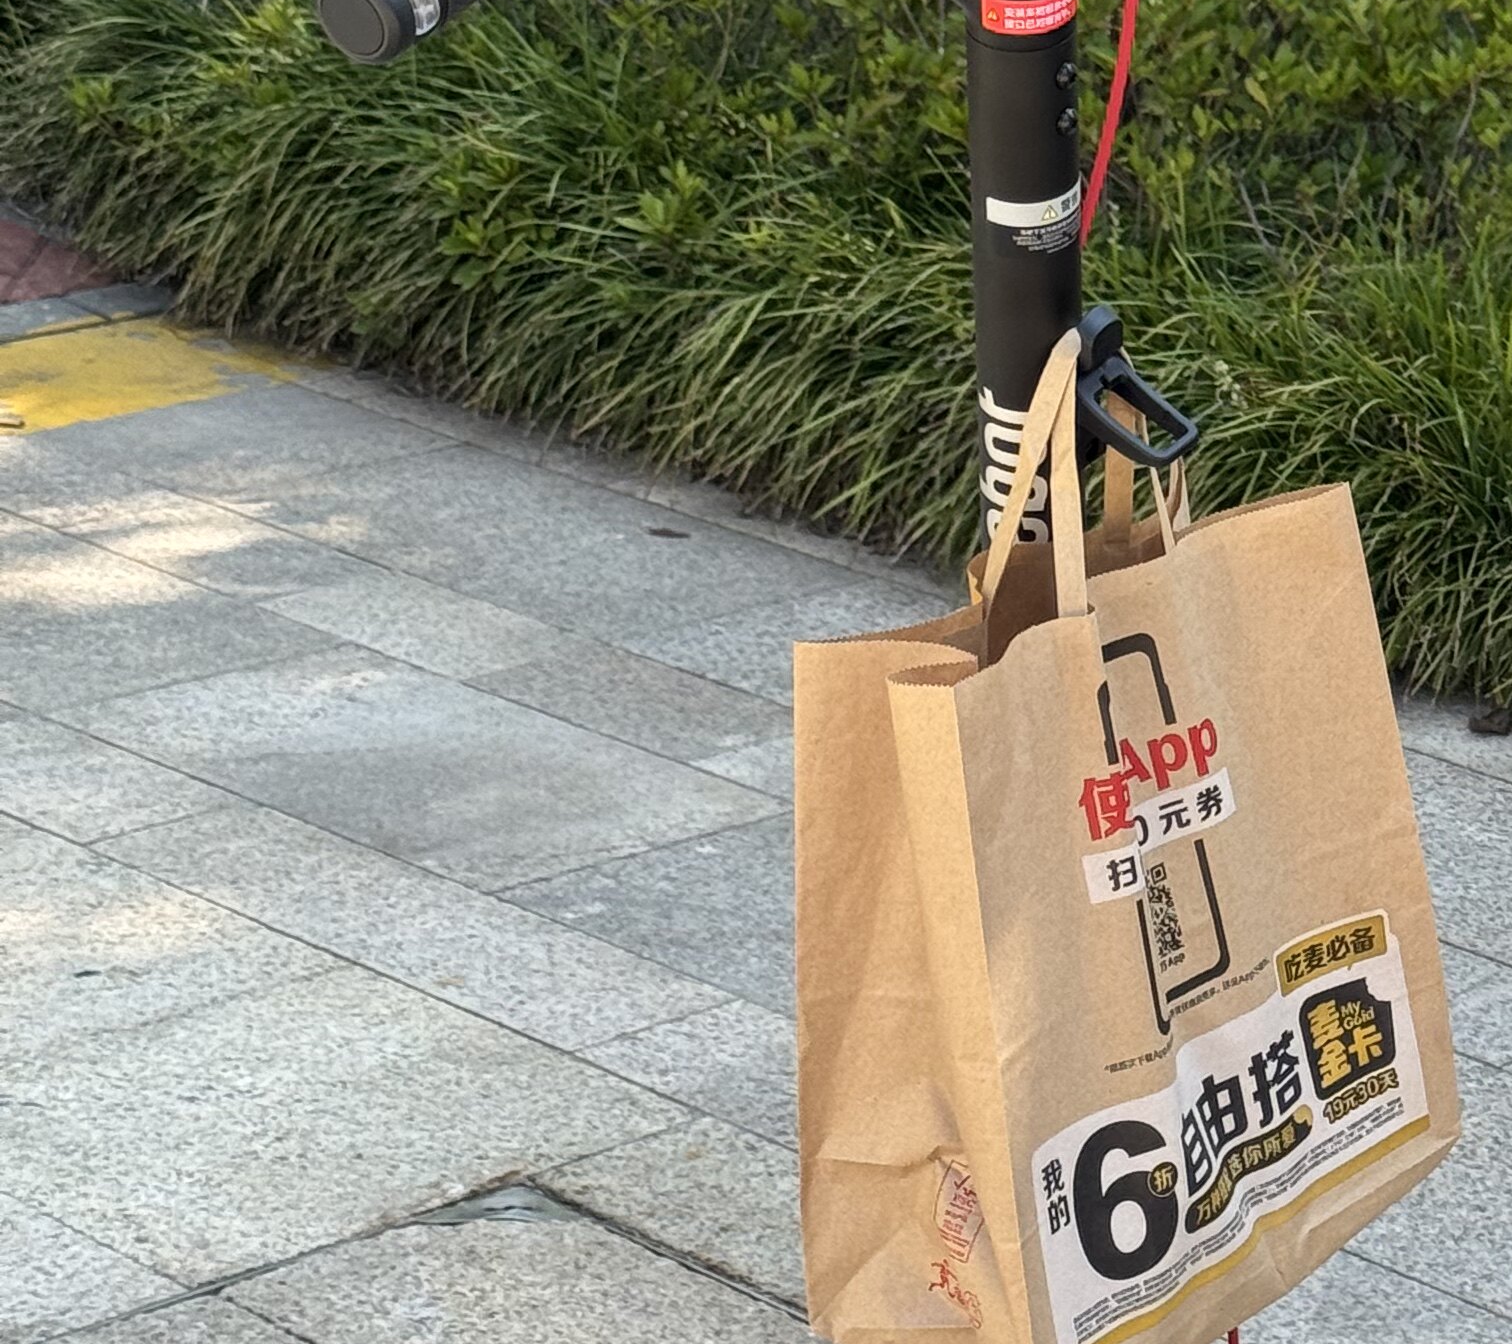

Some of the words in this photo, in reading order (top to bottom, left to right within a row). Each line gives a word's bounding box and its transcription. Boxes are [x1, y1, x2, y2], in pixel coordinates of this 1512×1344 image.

[1118, 717, 1218, 792] App
[1106, 855, 1138, 892] 扫
[1283, 925, 1376, 984] 吃麦必备
[1340, 1000, 1363, 1019] My
[1323, 1067, 1400, 1124] 19元30天
[1041, 1158, 1071, 1236] 我的
